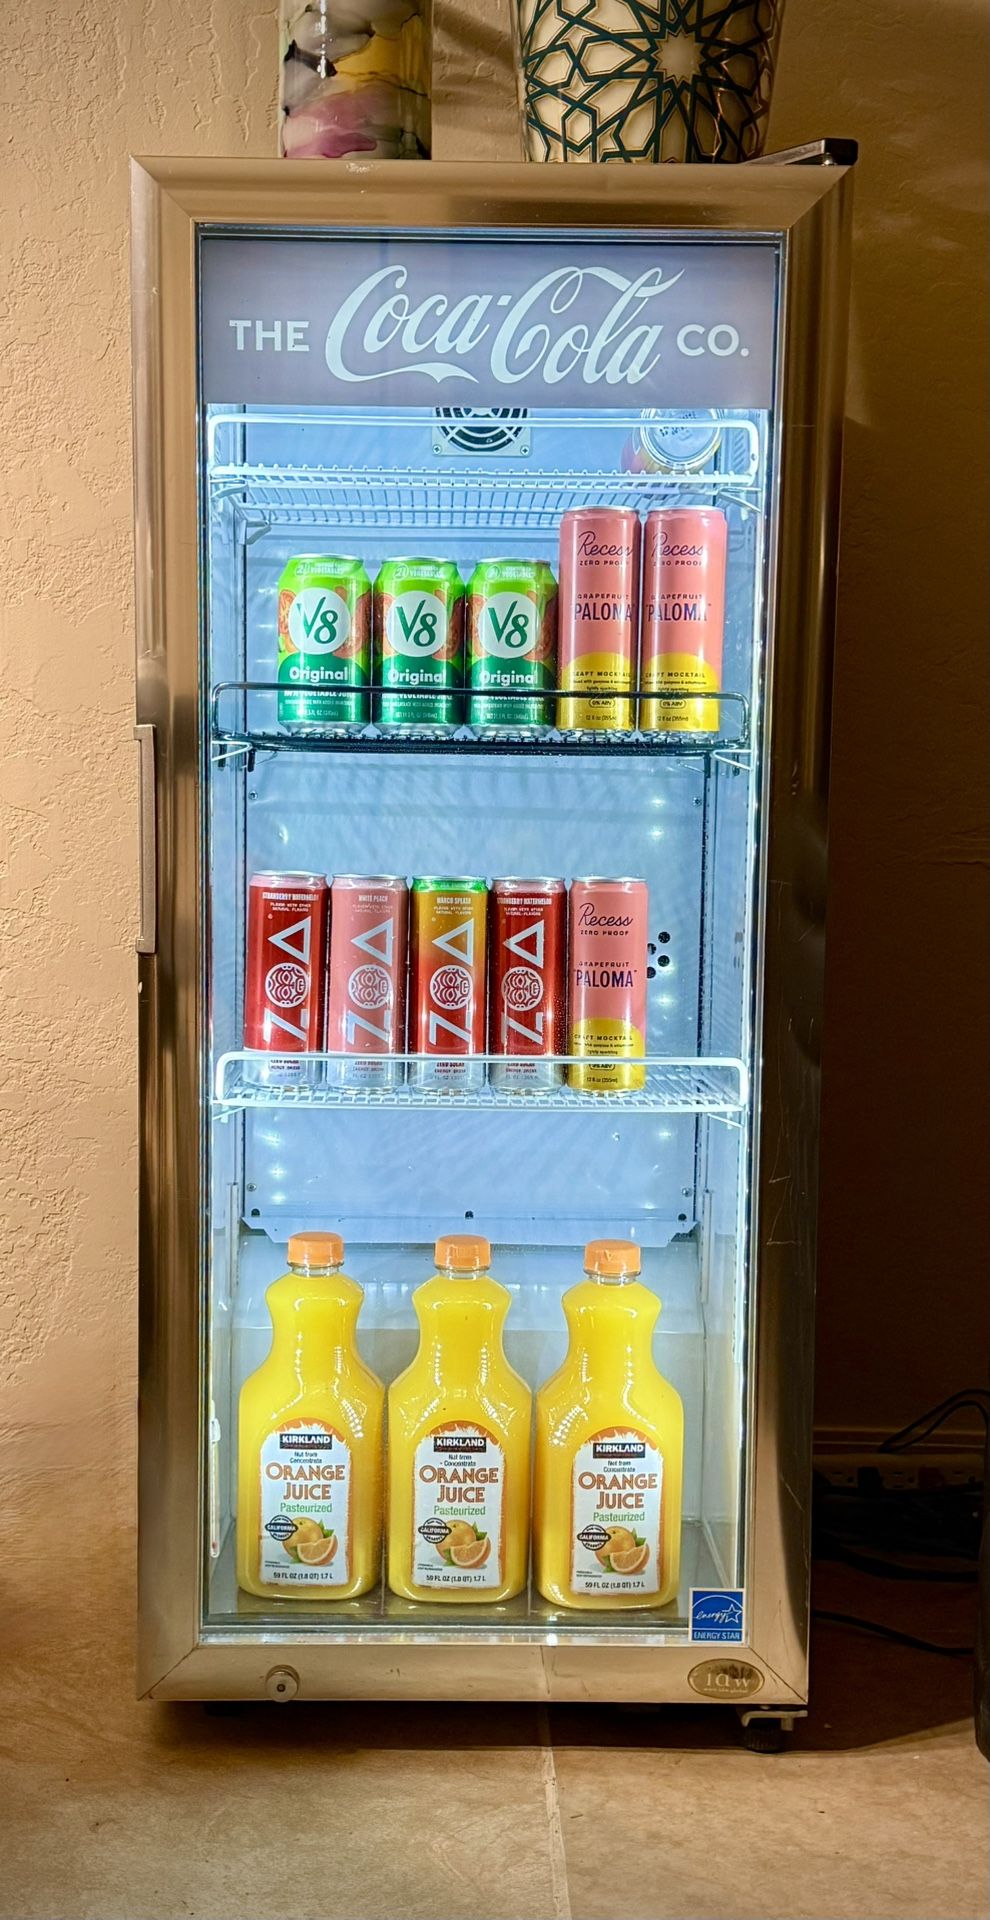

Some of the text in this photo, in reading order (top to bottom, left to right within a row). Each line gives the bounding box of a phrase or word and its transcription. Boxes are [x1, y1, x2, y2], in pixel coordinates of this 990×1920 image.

[229, 264, 750, 384] THE Coca-Cola CO.
[577, 531, 633, 557] Recess
[579, 559, 629, 567] ZERO PRO
[297, 597, 339, 645] V8
[396, 599, 438, 647] V8
[488, 600, 530, 648] V8
[289, 667, 348, 686] Original
[388, 669, 446, 685] Original
[479, 670, 538, 687] Original
[578, 902, 634, 927] Recess
[282, 1435, 331, 1445] KIRKLAND
[436, 1438, 485, 1447] KIRKLAND
[596, 1444, 644, 1453] KIRKLAND
[265, 1462, 345, 1481] ORANGE
[419, 1465, 498, 1484] ORANGE
[578, 1471, 658, 1490] ORANGE
[283, 1482, 332, 1501] JUICE
[436, 1485, 485, 1503] JUICE
[596, 1491, 644, 1509] JUICE
[280, 1502, 333, 1513] Pasteurized
[433, 1505, 486, 1516] Pasteurized
[593, 1511, 645, 1522] Pasteurized
[281, 1572, 289, 1580] FL
[289, 1572, 297, 1580] OZ
[593, 1581, 600, 1589] FL
[693, 1631, 741, 1640] ENERGY STAR
